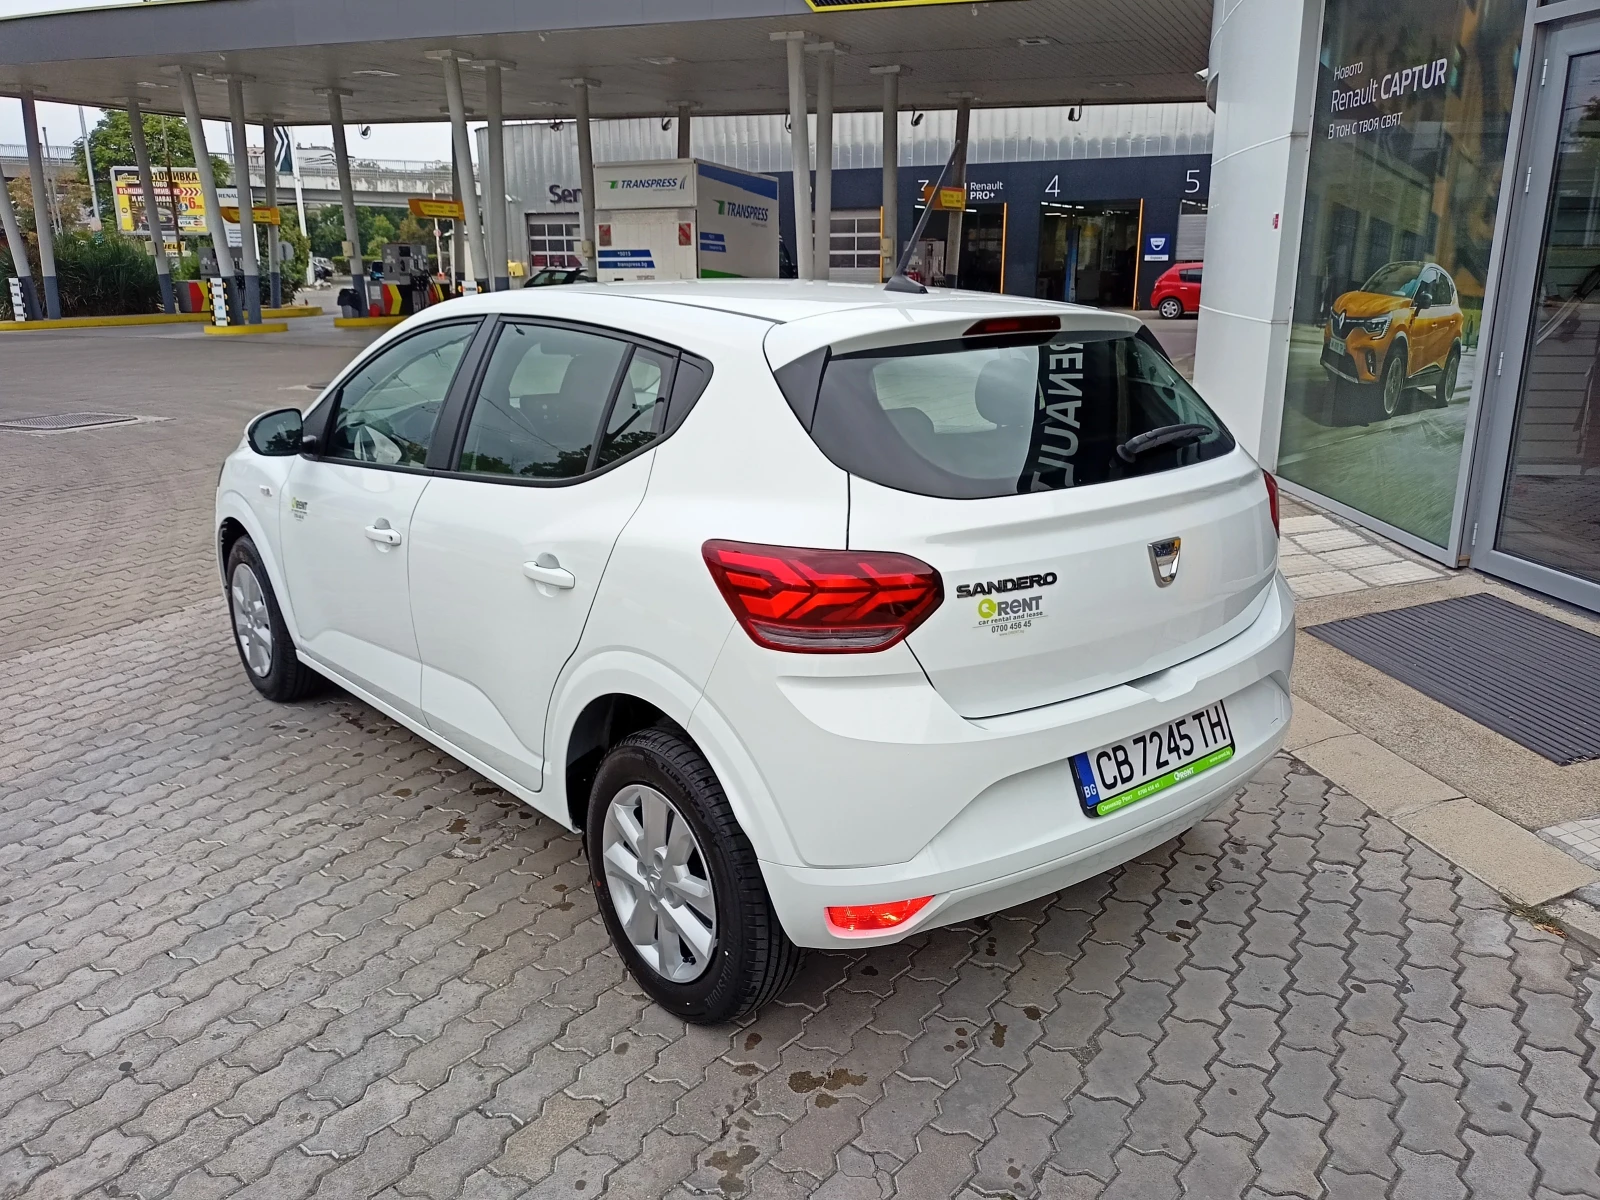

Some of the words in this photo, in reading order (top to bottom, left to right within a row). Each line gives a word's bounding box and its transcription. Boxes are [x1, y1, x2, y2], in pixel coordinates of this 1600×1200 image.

[1333, 61, 1364, 81] Новото
[1330, 78, 1379, 113] Renault
[1380, 58, 1448, 100] CAPTUR
[1327, 123, 1335, 140] В
[621, 178, 678, 189] TRANSPRESS
[970, 181, 1004, 190] Renault
[1045, 174, 1061, 198] 4
[1184, 169, 1200, 194] 5
[188, 196, 196, 210] 6
[970, 191, 996, 200] PRO+
[727, 201, 769, 222] TRANSPRESS
[956, 572, 1058, 599] SANDERO
[990, 615, 1012, 624] rental
[1012, 613, 1025, 621] and
[1026, 610, 1044, 619] lease
[991, 623, 1008, 634] 0700
[1009, 621, 1022, 631] 456
[1023, 619, 1032, 628] 45
[1083, 783, 1097, 798] BG
[1132, 718, 1194, 777] 7245
[1191, 705, 1227, 749] TH
